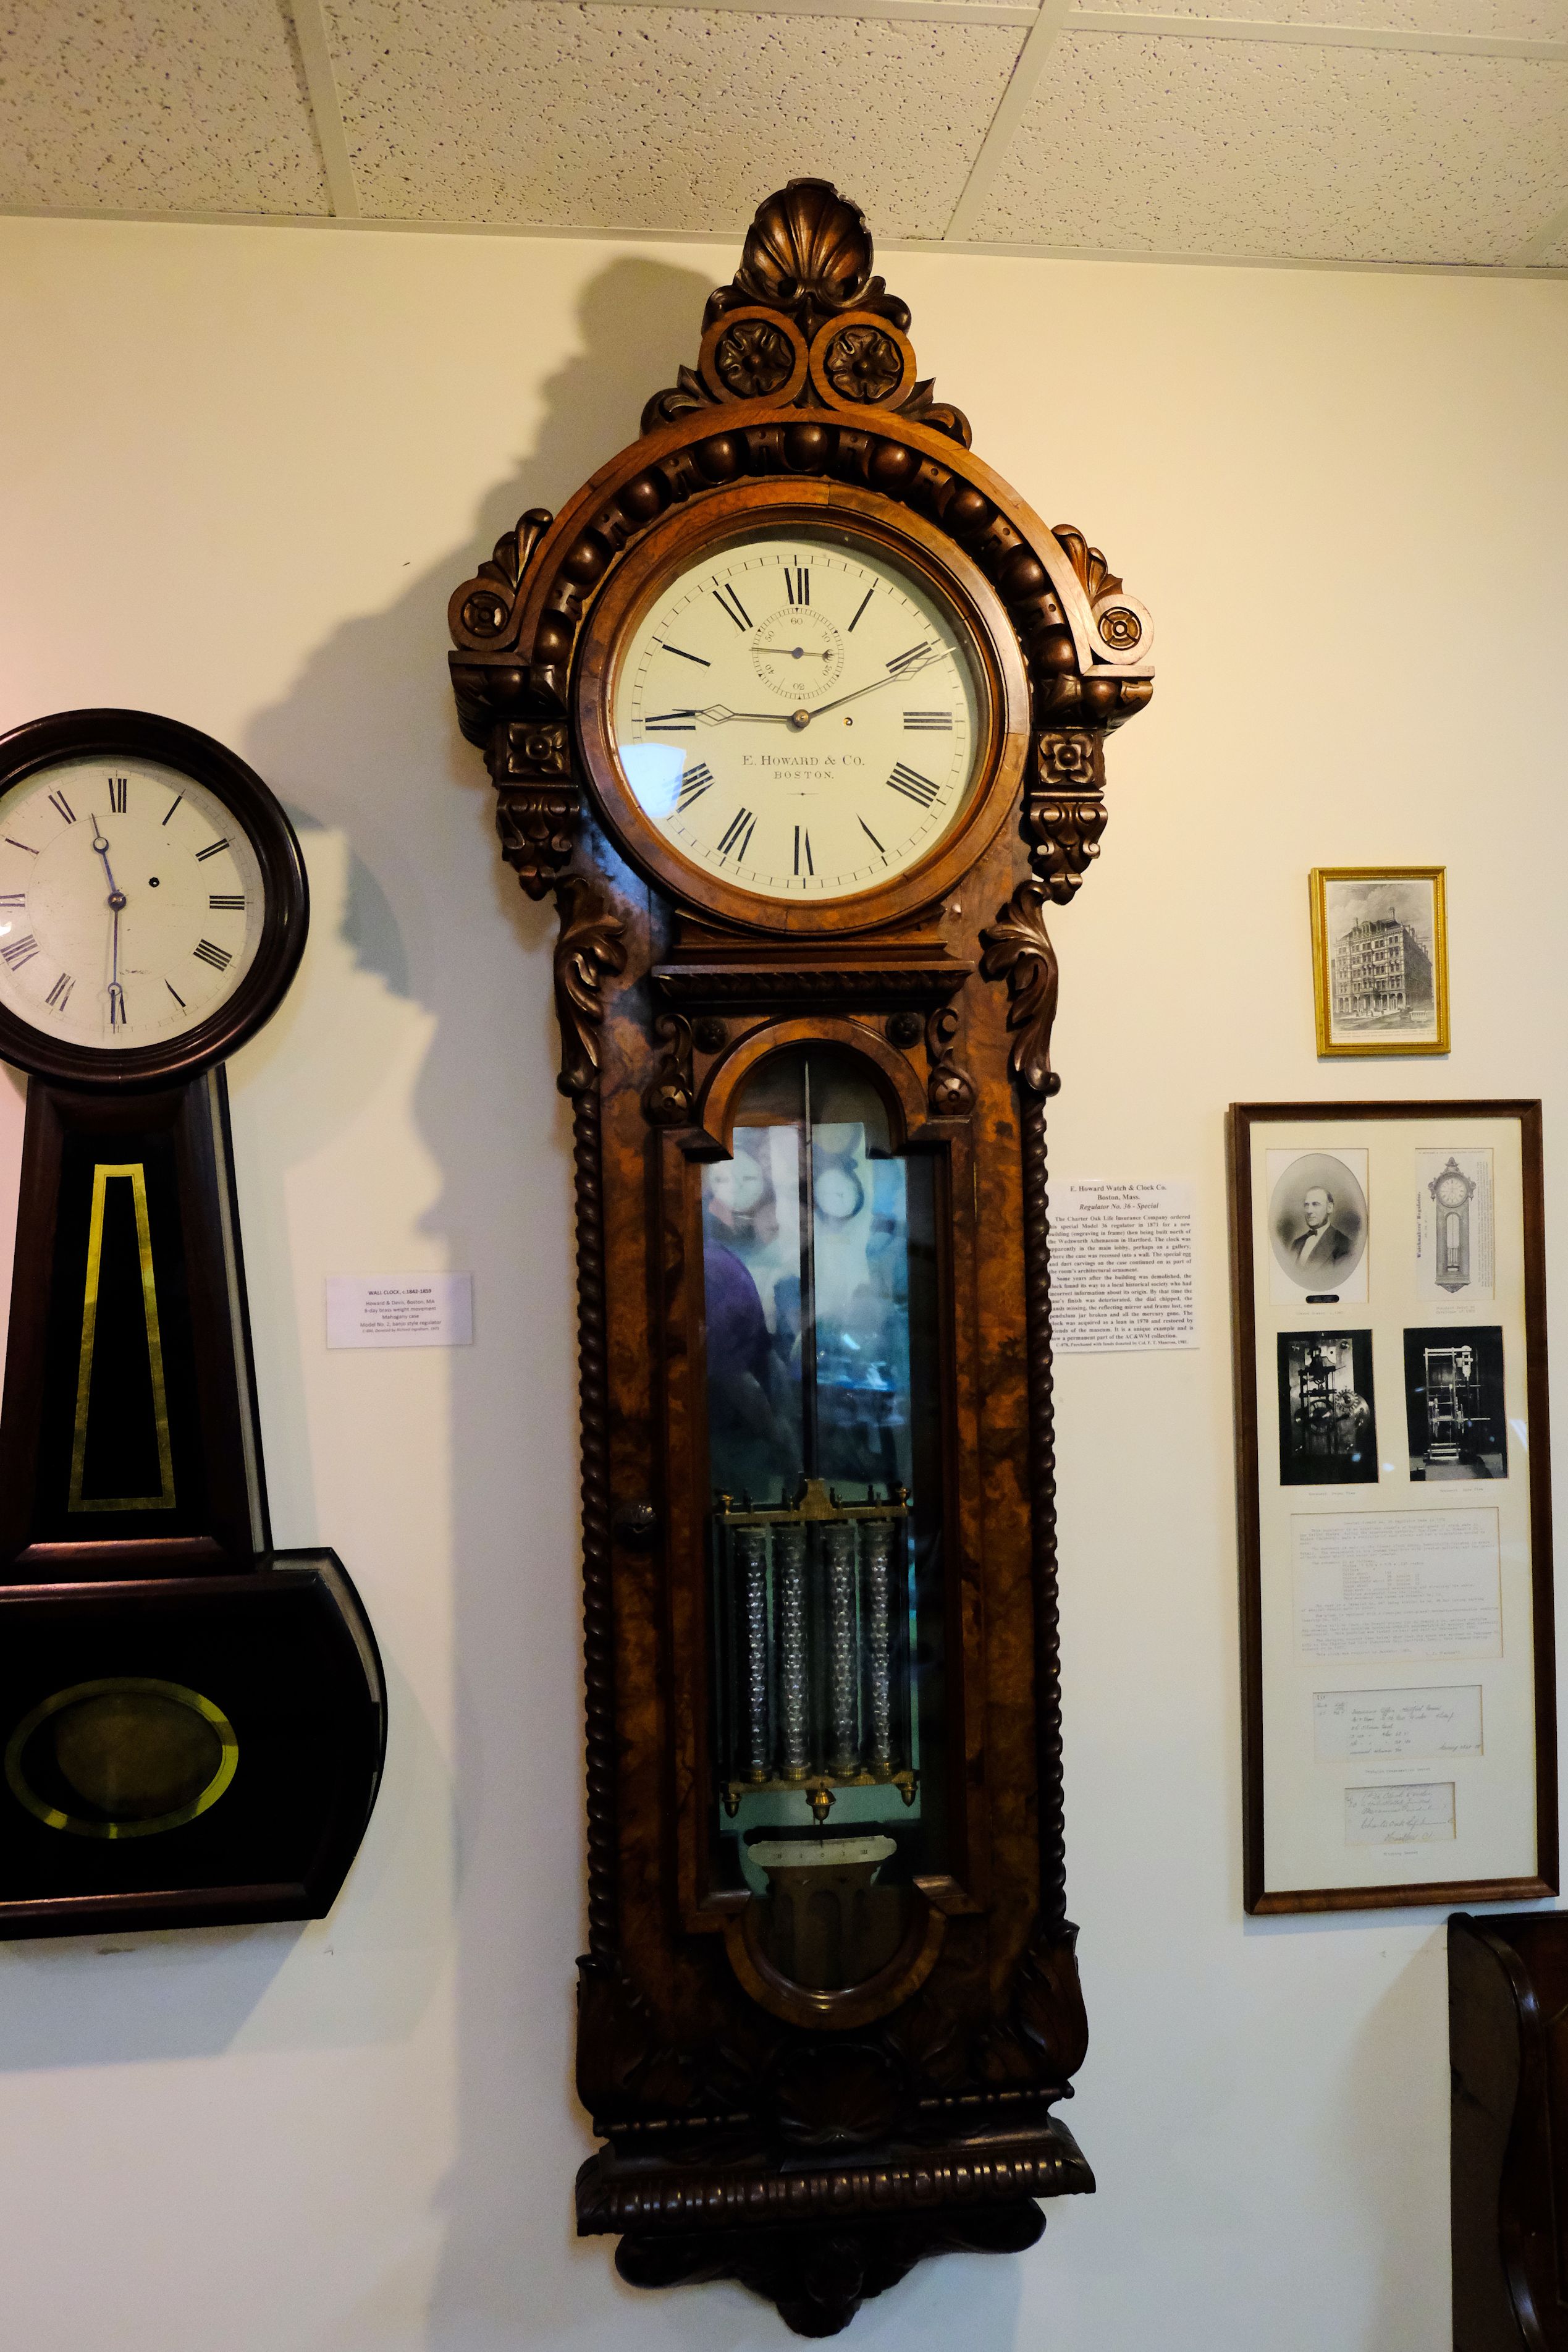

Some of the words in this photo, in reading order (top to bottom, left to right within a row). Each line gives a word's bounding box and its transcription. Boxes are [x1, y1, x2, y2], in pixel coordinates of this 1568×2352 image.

[782, 567, 811, 606] XII
[791, 617, 803, 625] 60
[764, 630, 775, 643] 50
[821, 631, 831, 643] 10
[764, 664, 775, 675] 40
[822, 664, 833, 676] 20
[793, 682, 805, 690] 30
[903, 711, 953, 730] III
[741, 755, 756, 766] E.
[824, 756, 836, 766] &
[773, 771, 835, 779] BOSTON.
[107, 777, 129, 814] XII
[195, 837, 230, 862] II
[793, 824, 814, 876] VI
[209, 894, 246, 911] III
